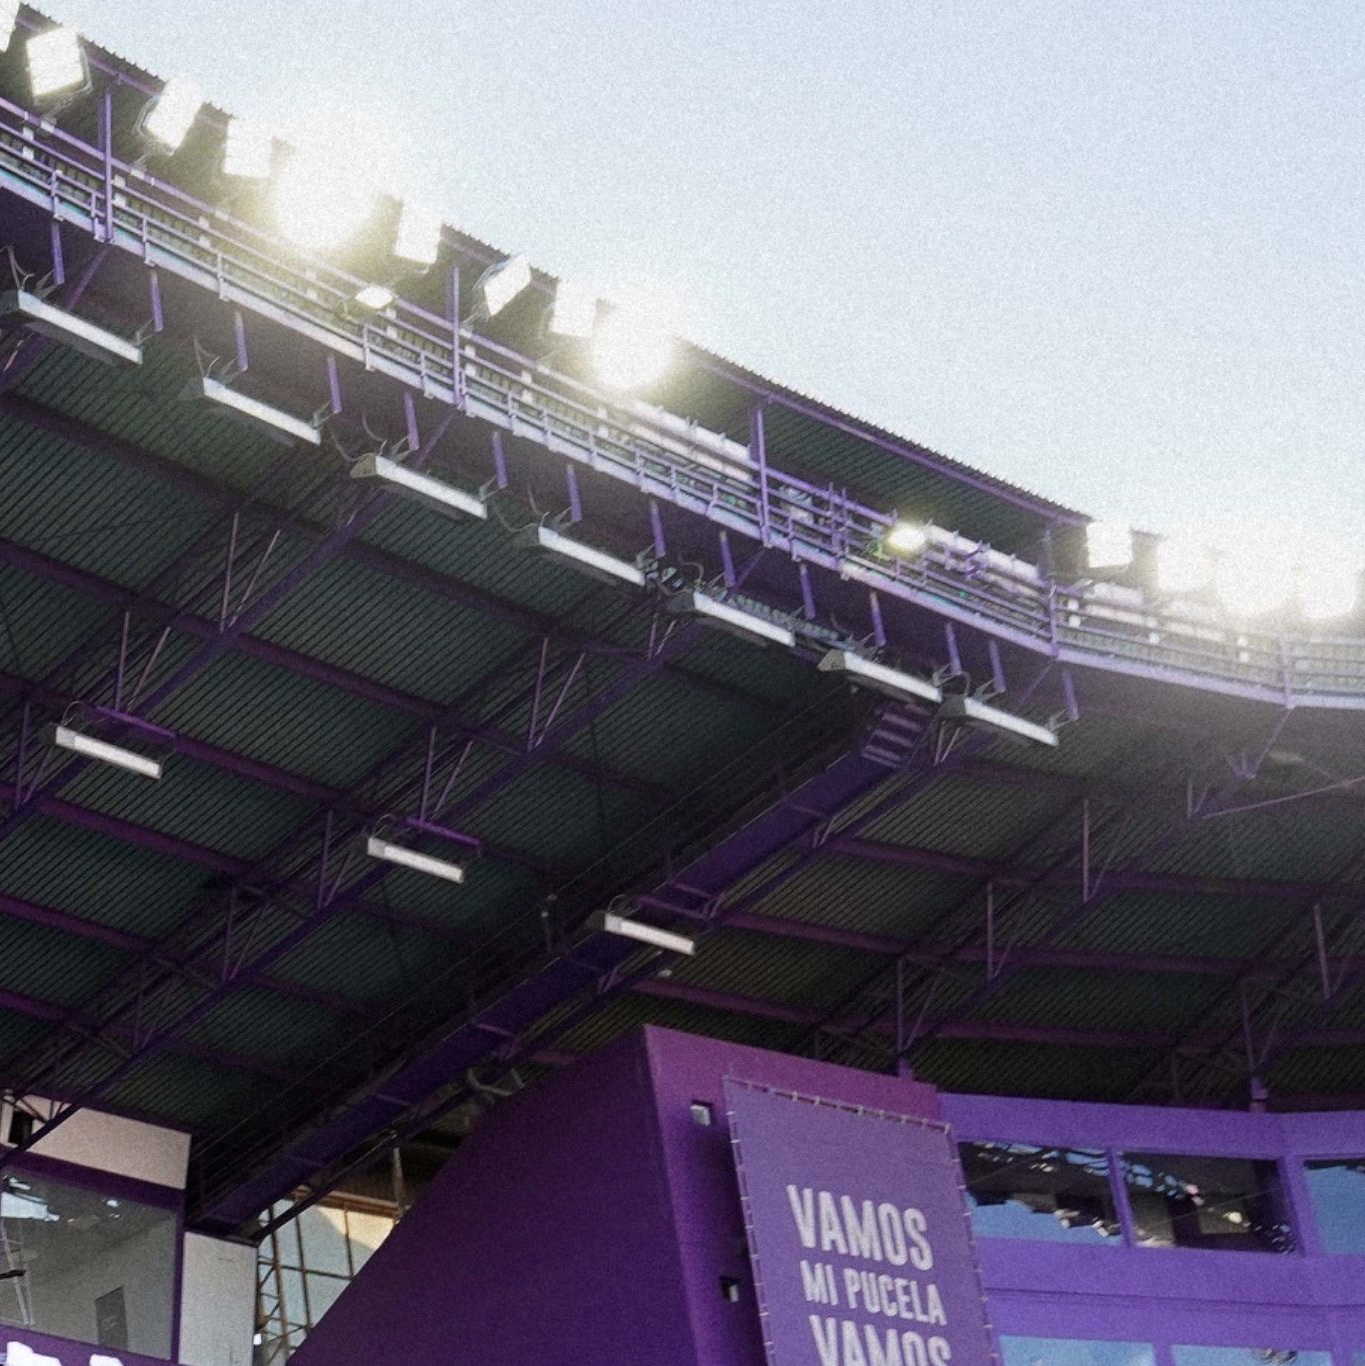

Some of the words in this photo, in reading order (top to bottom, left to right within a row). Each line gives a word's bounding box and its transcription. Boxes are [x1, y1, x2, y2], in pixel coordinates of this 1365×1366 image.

[786, 1184, 933, 1271] VAMOS
[800, 1260, 839, 1306] MI
[843, 1268, 948, 1326] PUCELA
